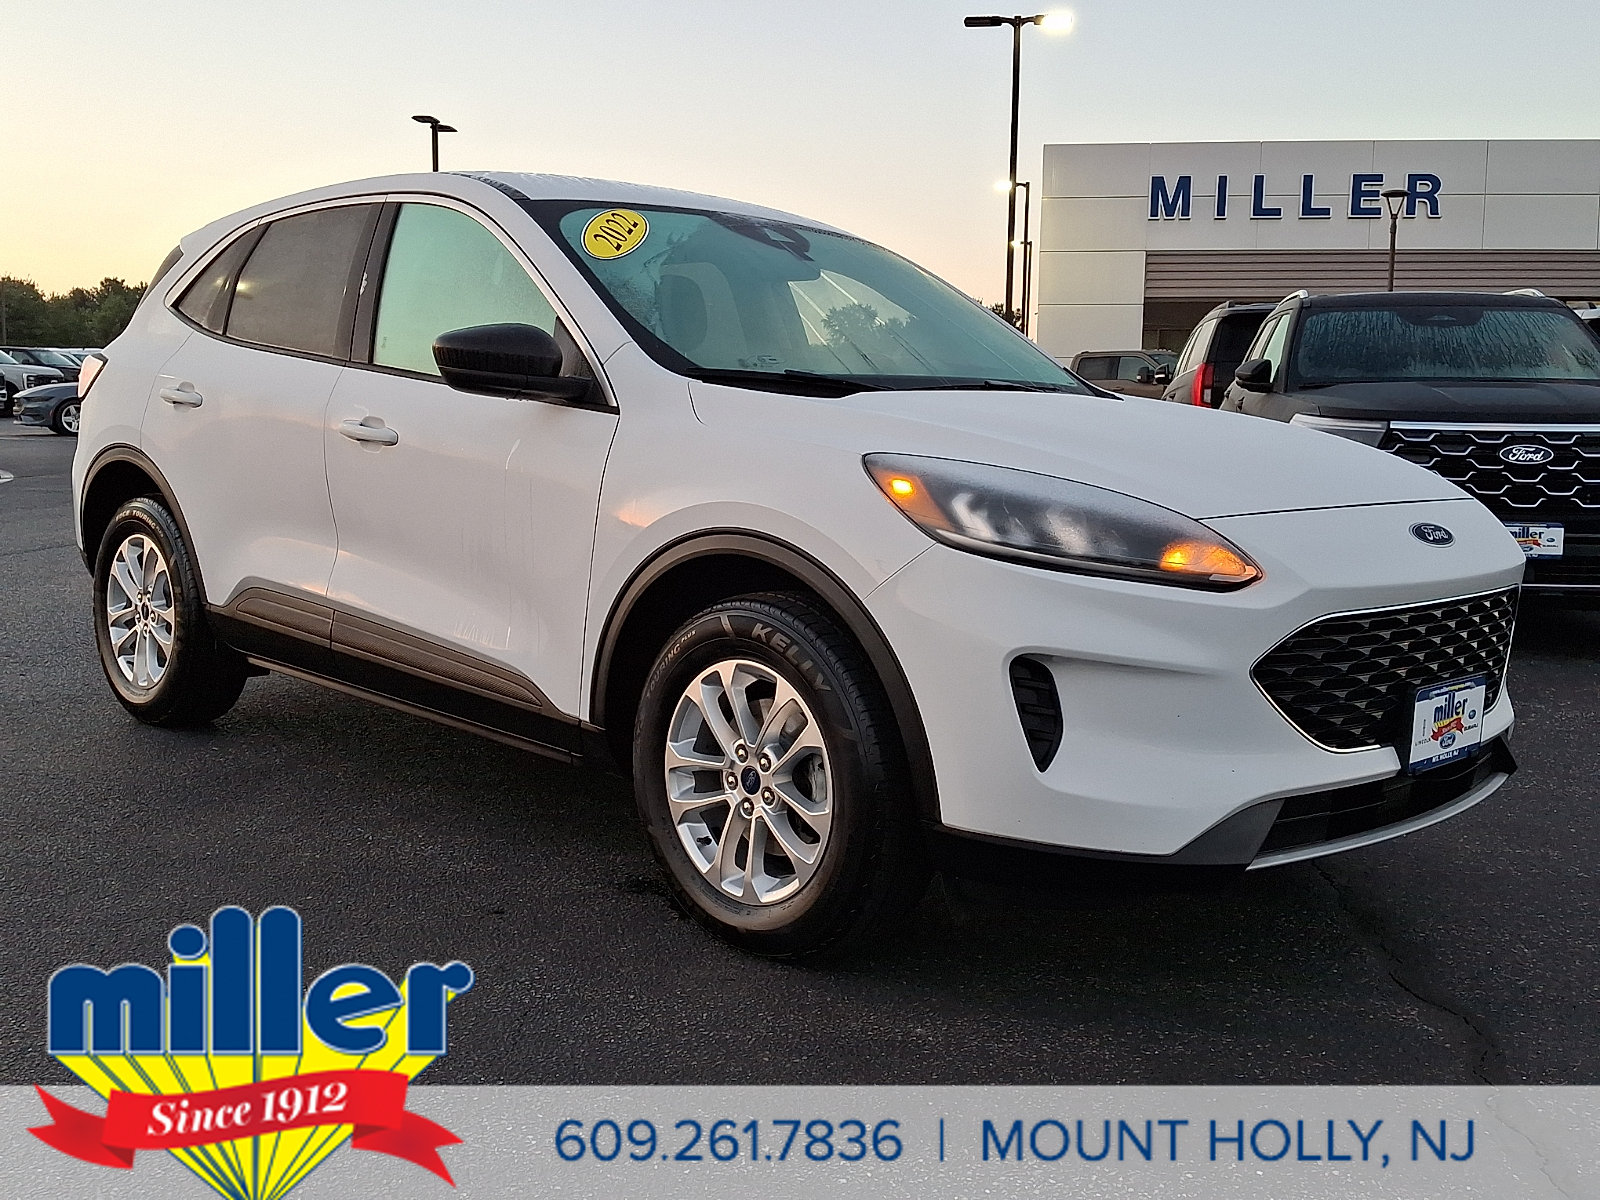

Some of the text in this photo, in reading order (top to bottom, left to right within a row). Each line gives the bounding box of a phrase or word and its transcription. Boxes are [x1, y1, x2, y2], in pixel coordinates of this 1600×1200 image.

[1148, 173, 1441, 219] MILLER
[592, 212, 639, 252] 2022
[1508, 446, 1545, 461] Ford
[132, 510, 156, 530] TOURING
[1422, 525, 1449, 541] Ford
[751, 622, 832, 691] KELLY
[1433, 691, 1468, 724] miller
